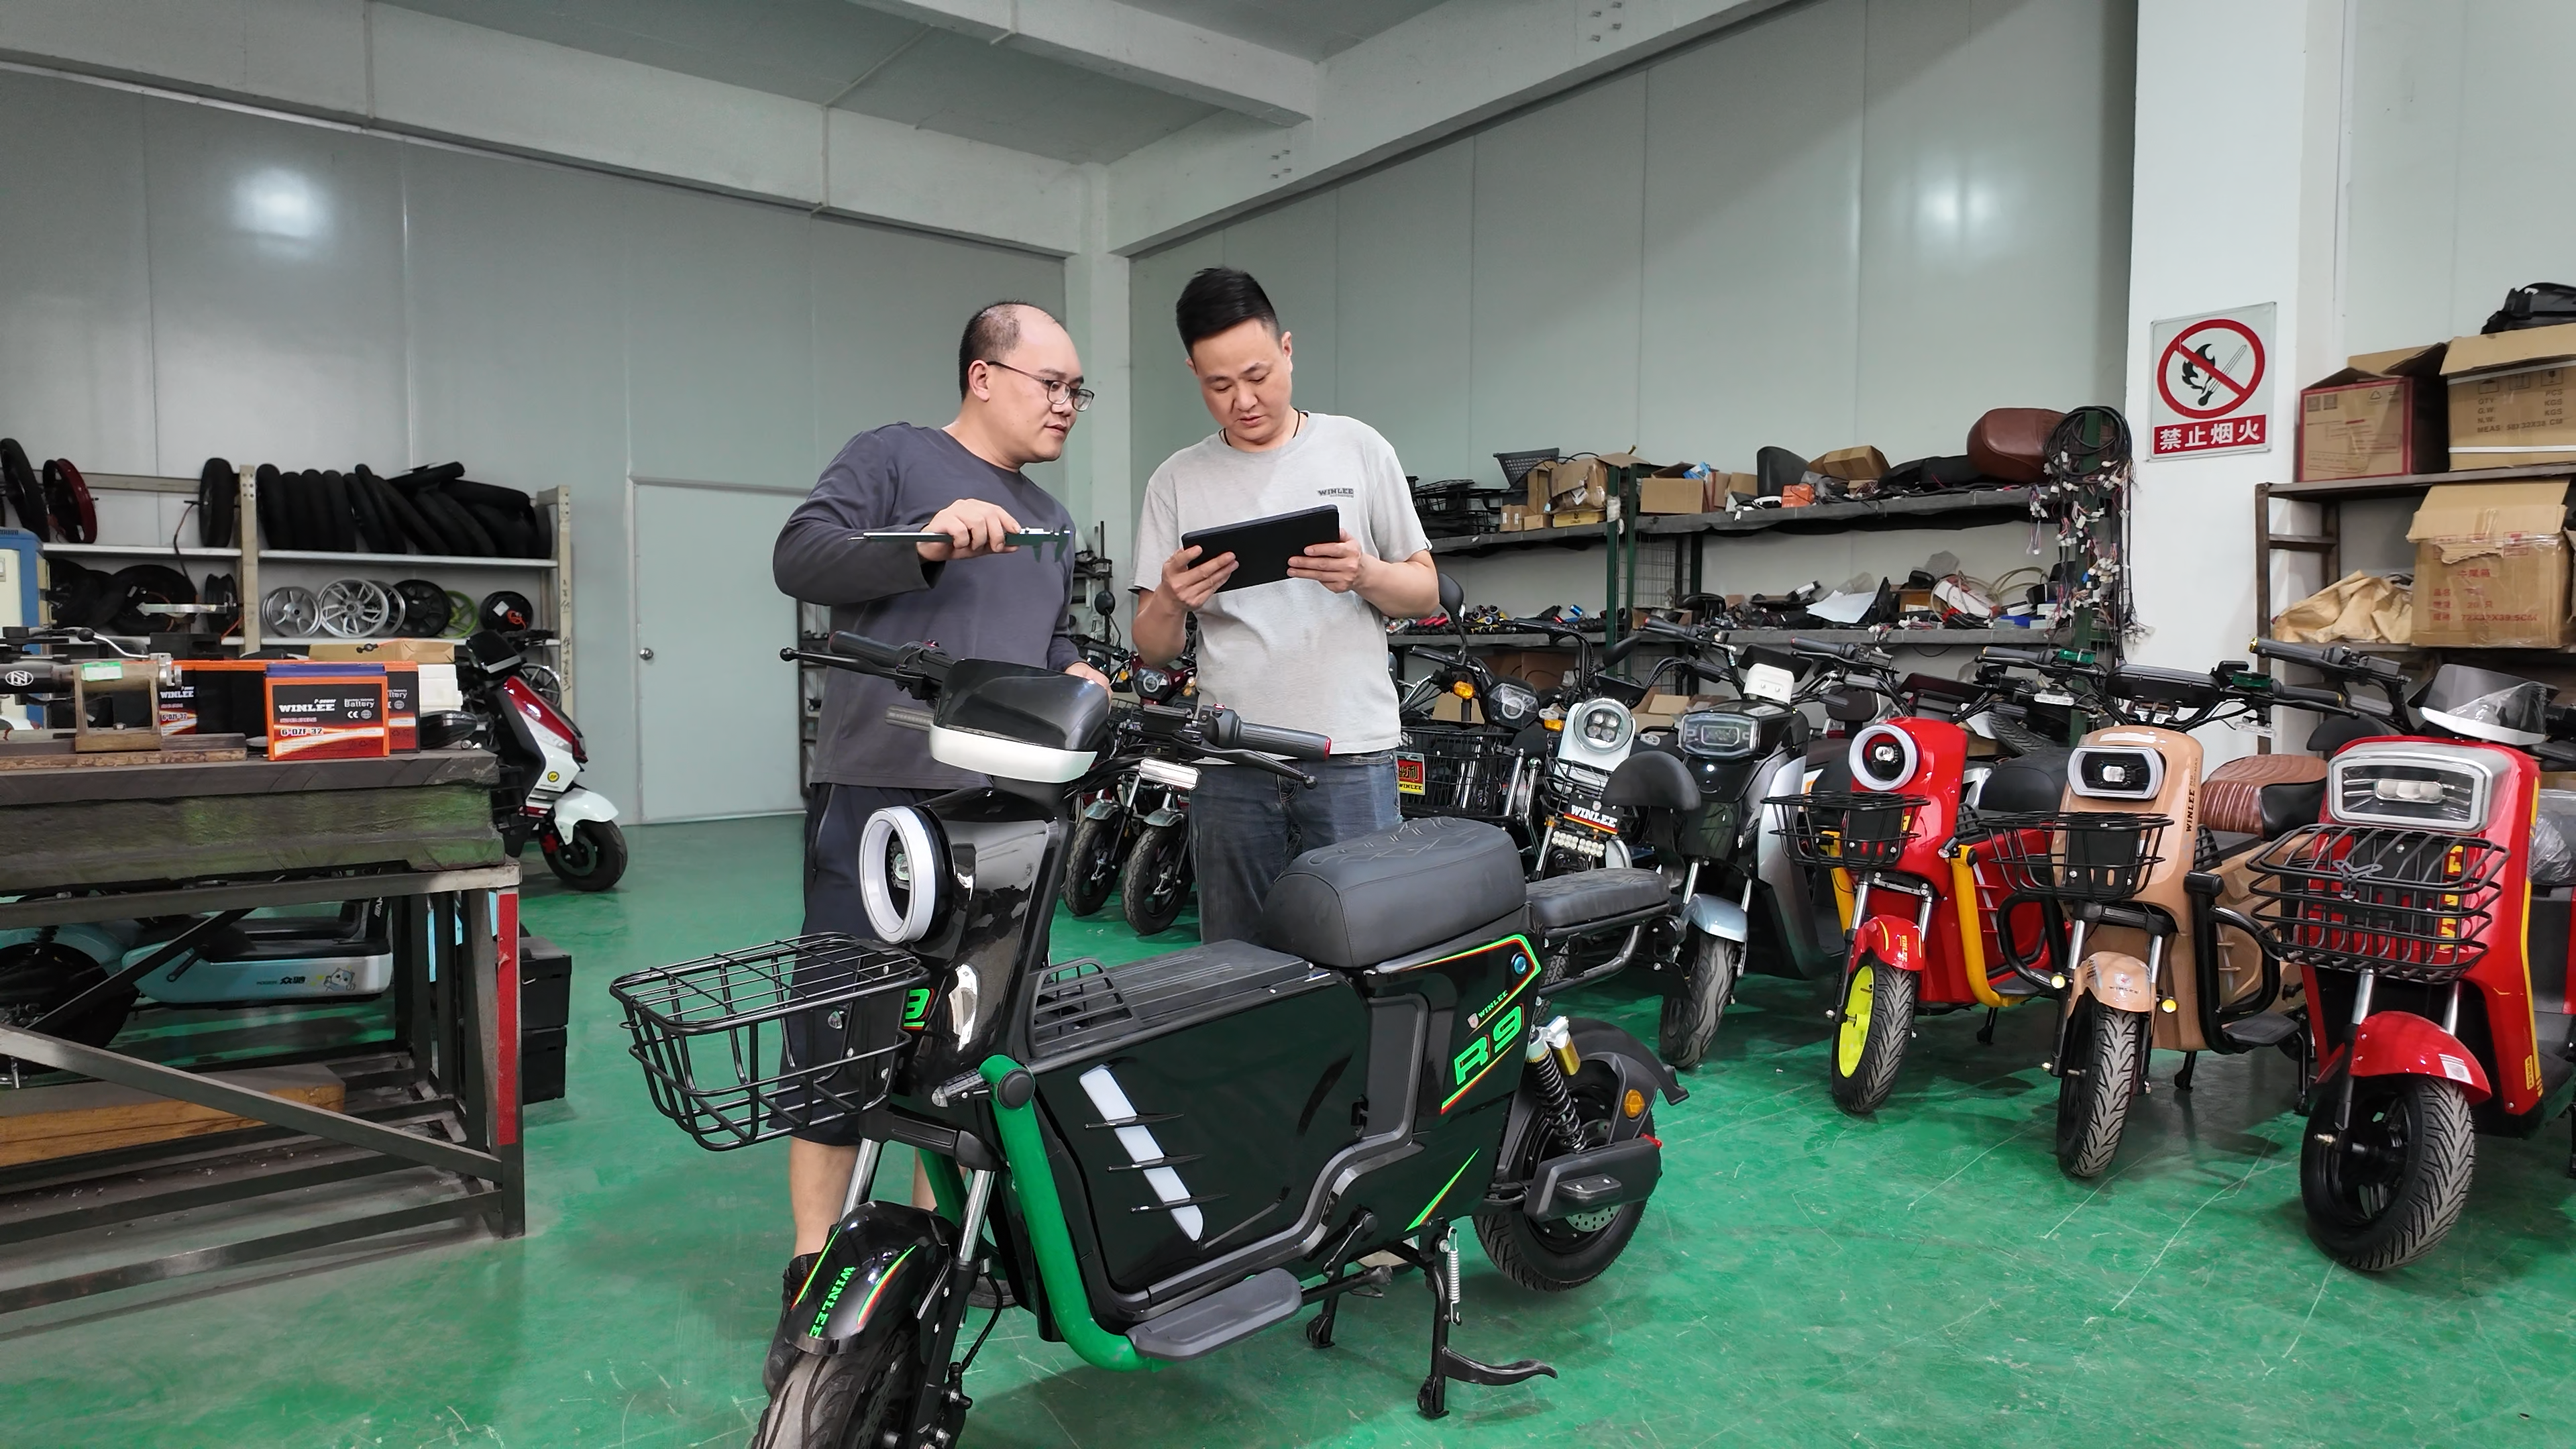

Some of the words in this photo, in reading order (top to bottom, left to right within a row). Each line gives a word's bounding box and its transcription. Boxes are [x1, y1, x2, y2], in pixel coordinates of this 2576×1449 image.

[2544, 398, 2563, 407] KGS
[2159, 419, 2260, 450] 禁止烟火
[1317, 488, 1354, 496] WINLEE
[278, 704, 335, 712] WINLEE
[1571, 804, 1617, 828] WINLEE
[2186, 789, 2195, 832] WINLEE
[1478, 989, 1508, 1018] WINLEE
[1454, 1005, 1523, 1085] R9
[809, 1267, 856, 1338] WINLEE
